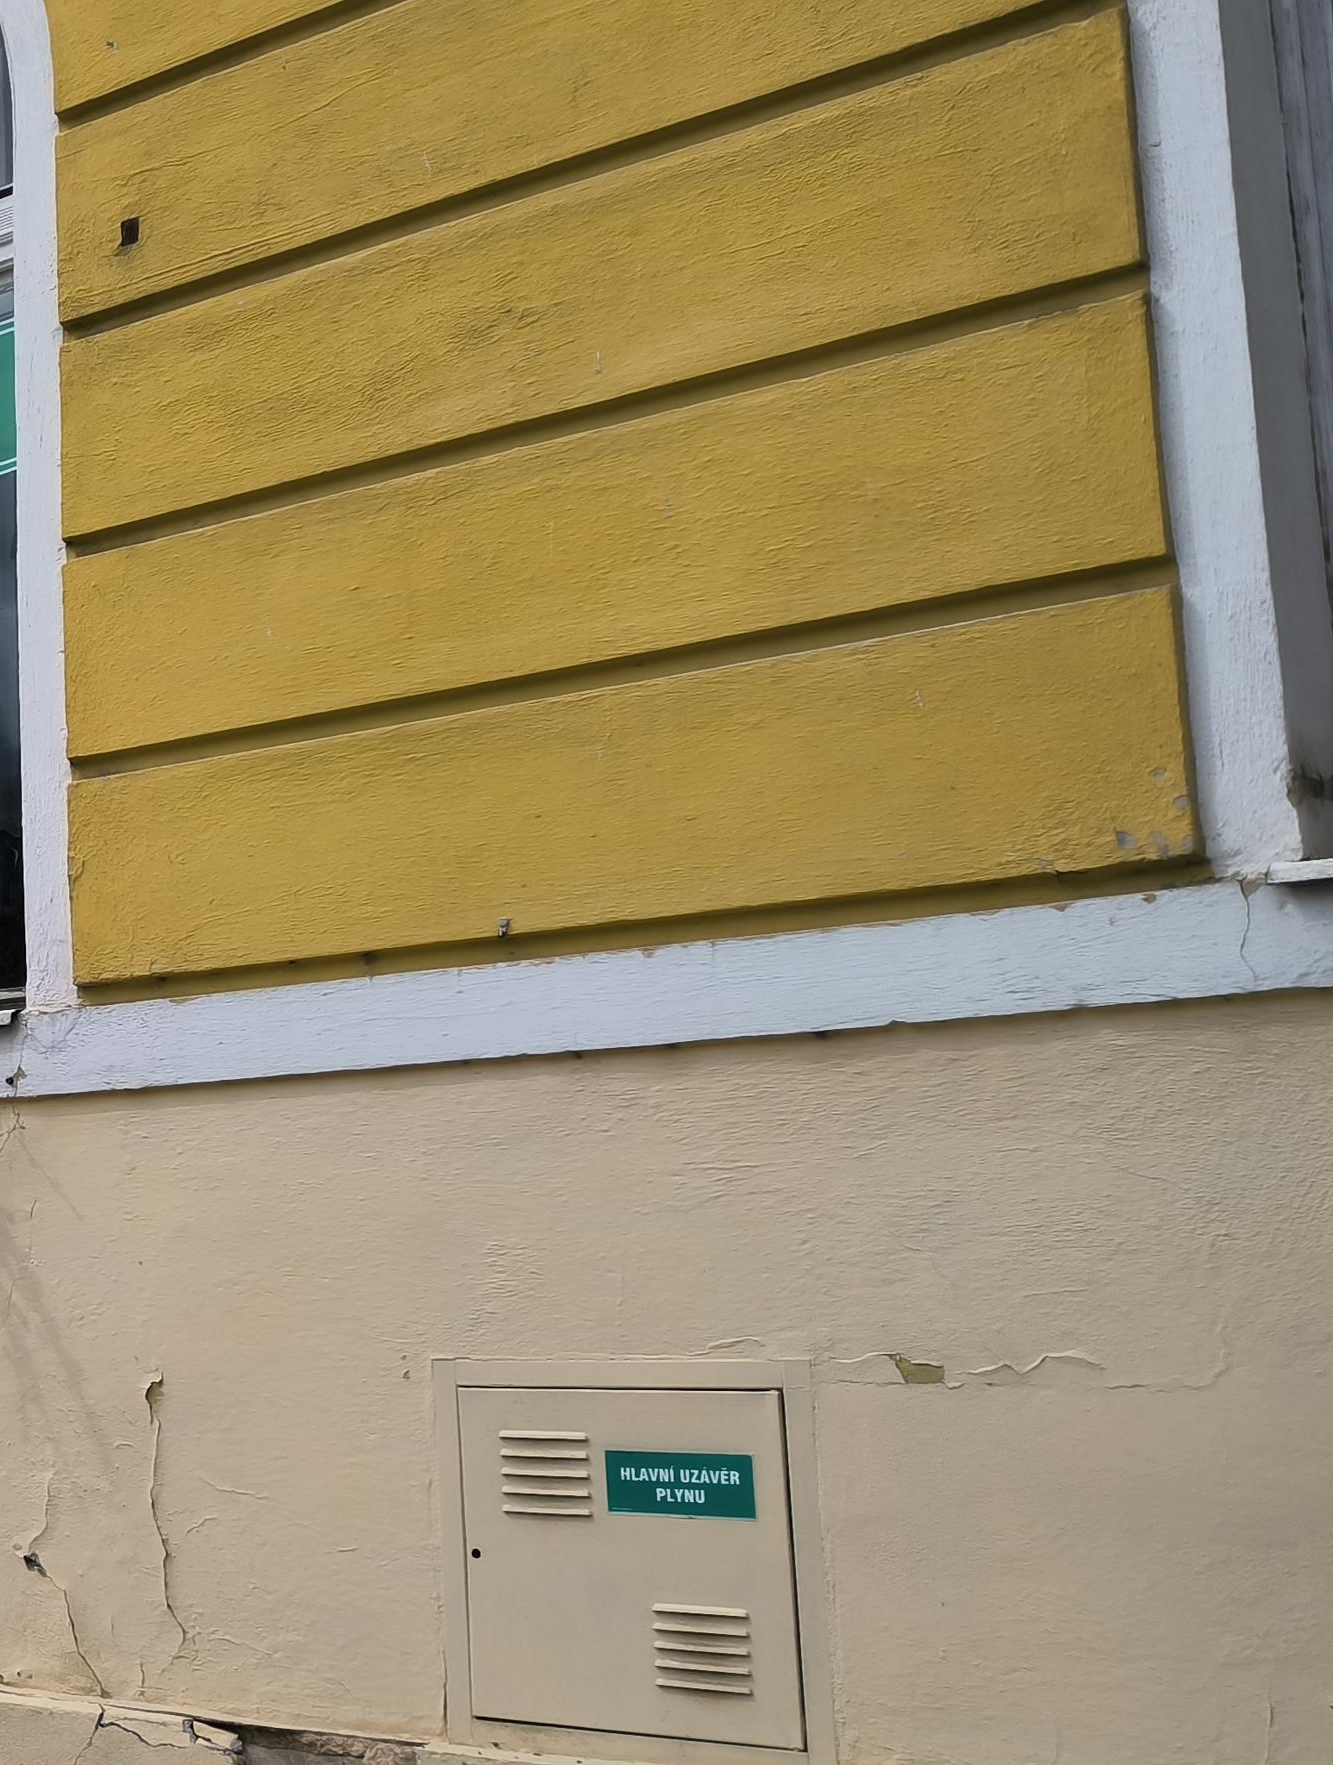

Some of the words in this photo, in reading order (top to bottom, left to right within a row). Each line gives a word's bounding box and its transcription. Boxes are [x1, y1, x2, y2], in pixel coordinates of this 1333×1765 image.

[620, 1465, 675, 1483] HLAVNÍ
[680, 1467, 741, 1485] UZÁVĚR
[655, 1487, 706, 1504] PLYNU
